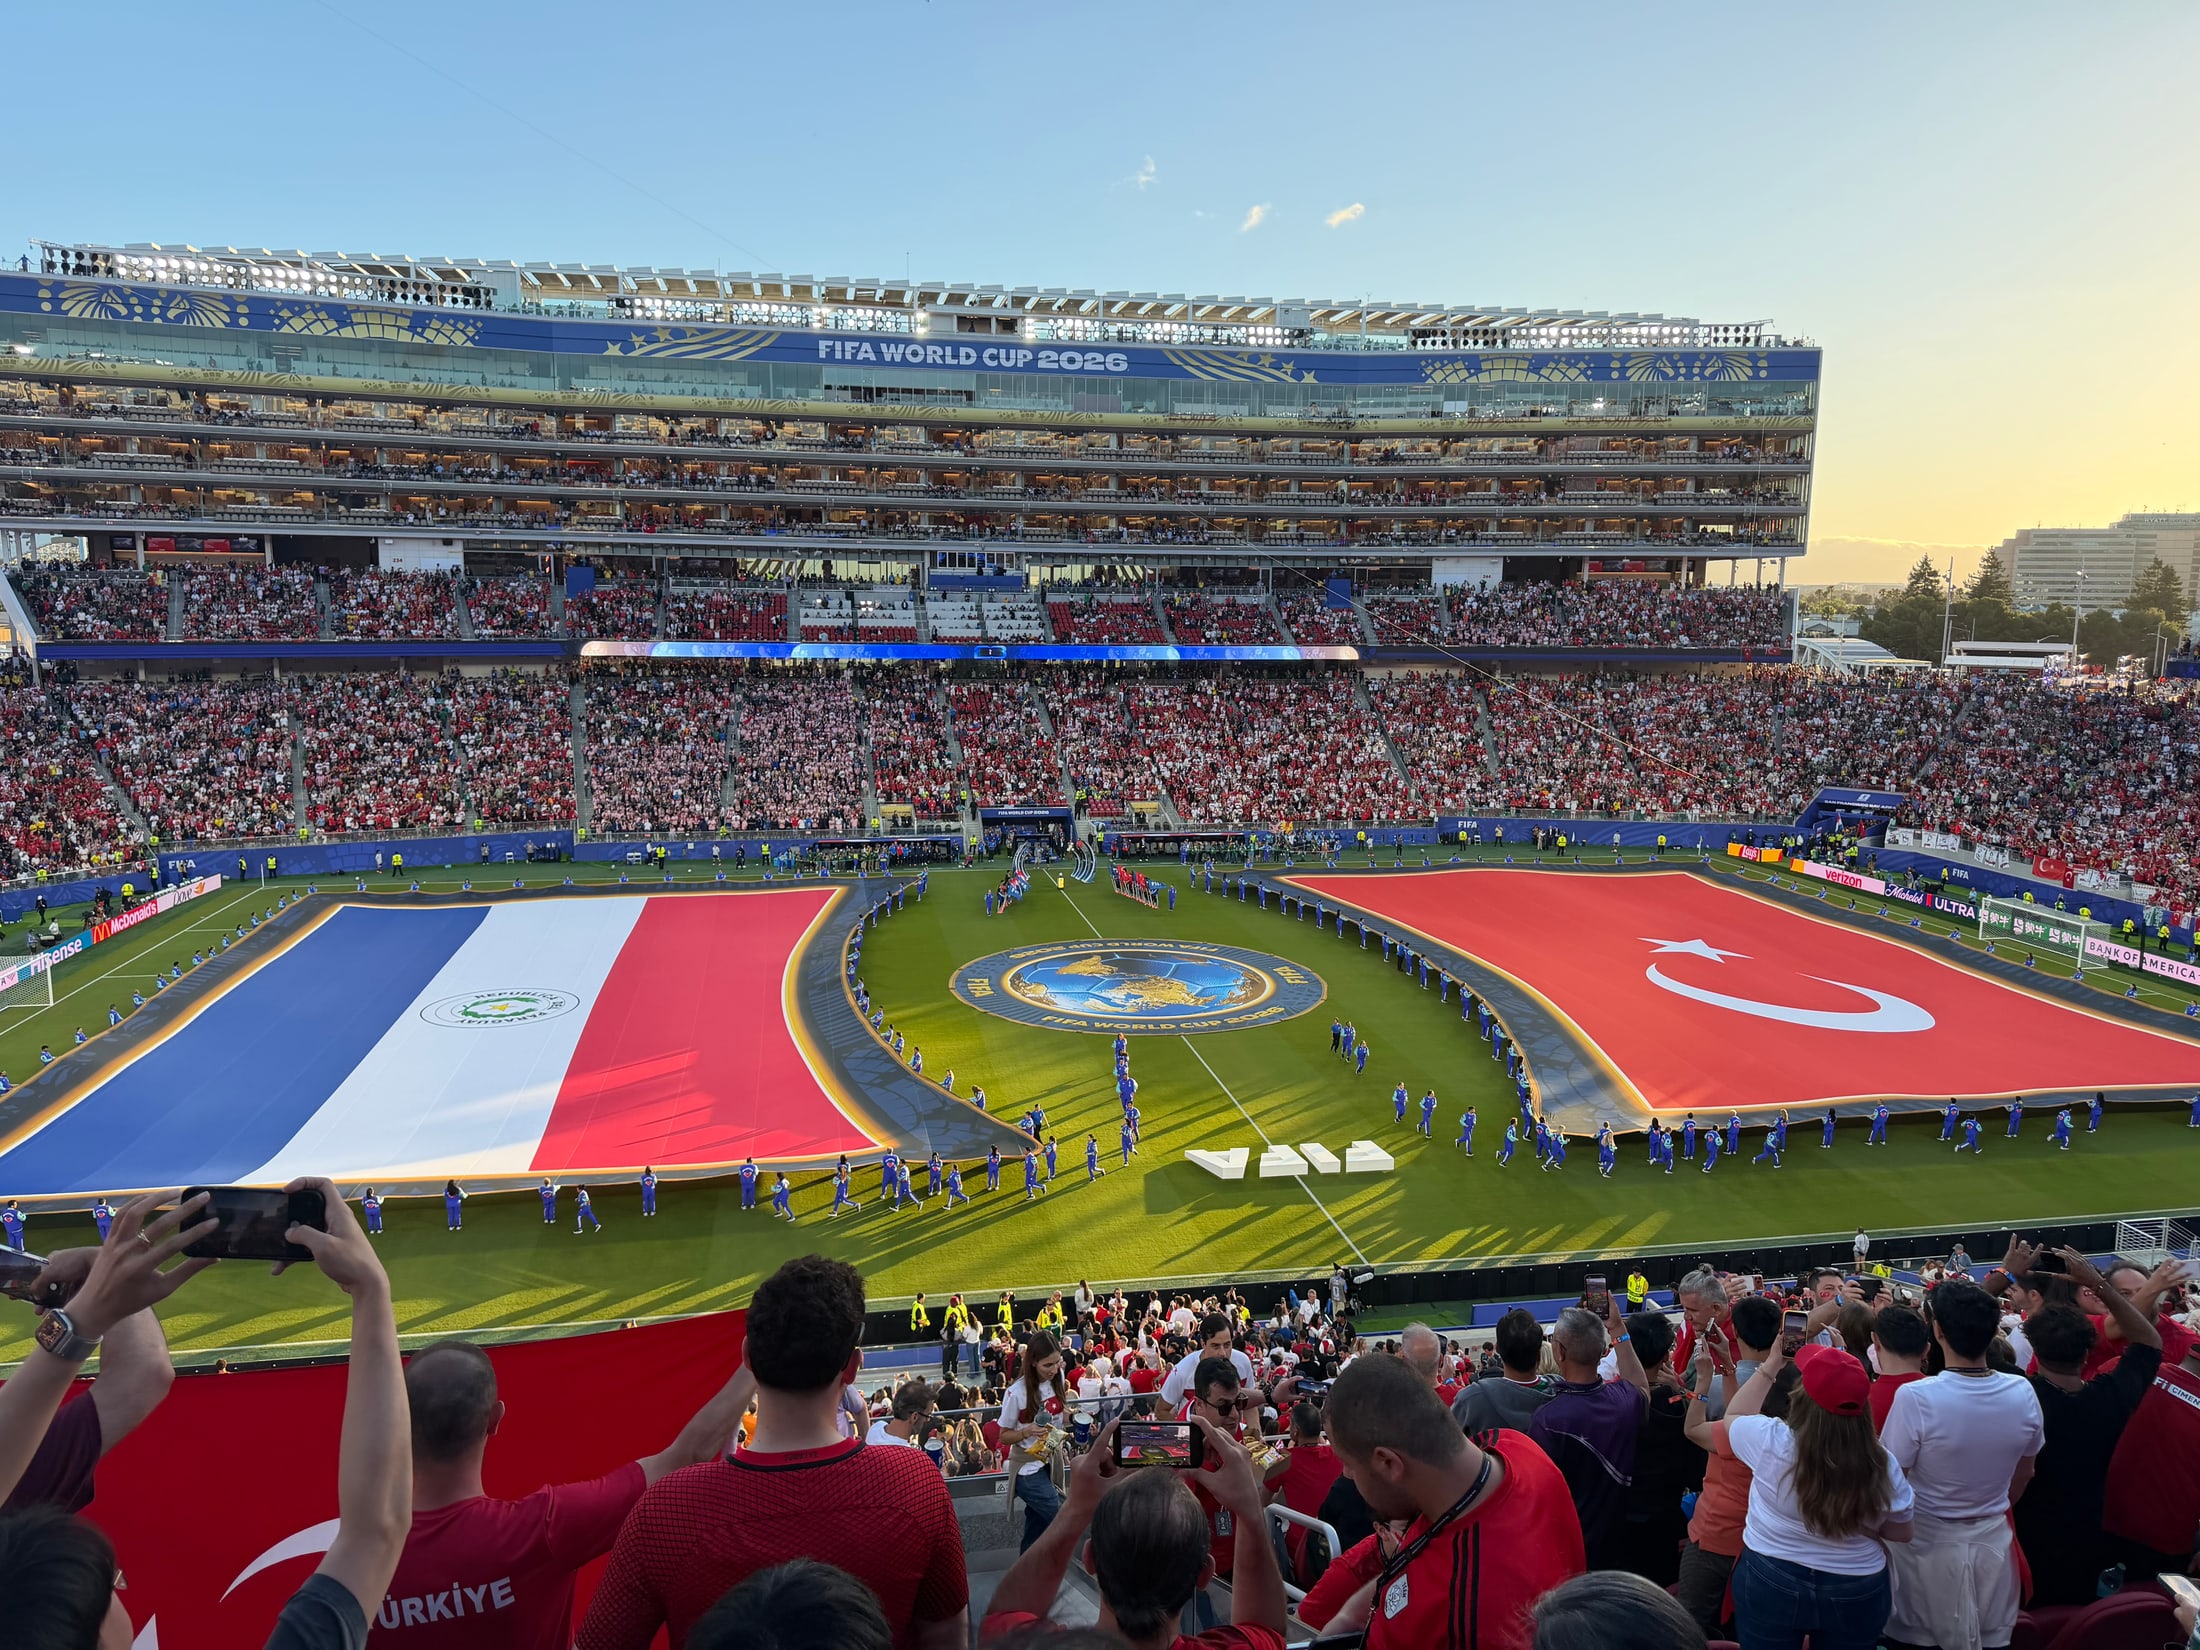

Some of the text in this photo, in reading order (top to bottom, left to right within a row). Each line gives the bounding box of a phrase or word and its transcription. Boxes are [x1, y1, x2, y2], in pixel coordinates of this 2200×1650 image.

[818, 340, 1128, 372] FIFA WORLD CUP 2026
[1825, 869, 1862, 889] verizon
[1952, 868, 1969, 880] FIFA
[173, 888, 192, 905] Dove
[1885, 884, 1976, 920] Michelob ULTRA
[111, 900, 157, 935] McDonald's
[2090, 941, 2120, 958] BANK
[2123, 951, 2138, 962] OF
[1273, 966, 1308, 984] FIFA
[968, 978, 994, 998] FIFA
[1041, 1006, 1285, 1030] FIFA WORLD CUP 2026
[1184, 1140, 1395, 1179] FIFA
[371, 1576, 516, 1629] ÜRKİYE
